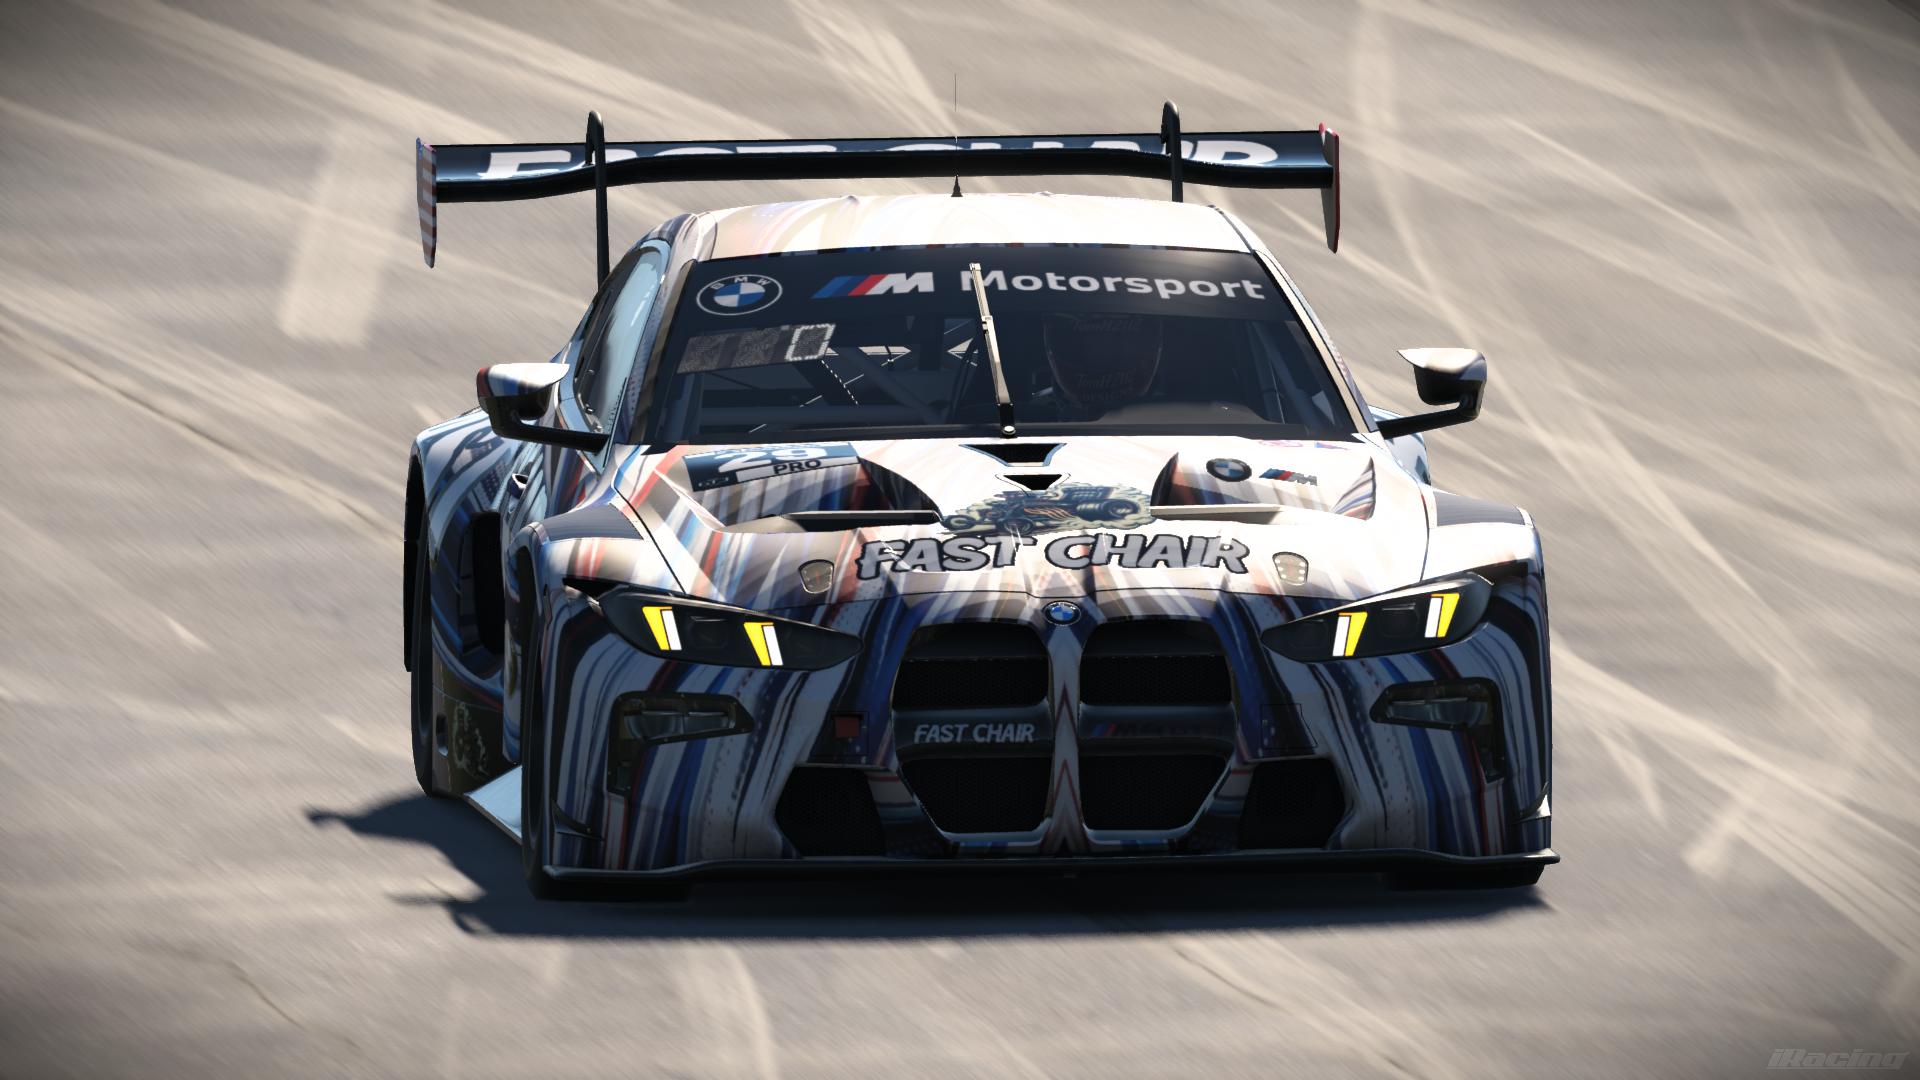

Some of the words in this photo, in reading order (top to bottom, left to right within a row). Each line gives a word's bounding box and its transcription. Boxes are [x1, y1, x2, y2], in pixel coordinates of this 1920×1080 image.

[865, 272, 934, 295] M
[961, 270, 1265, 299] Motorsport
[714, 448, 827, 473] 29
[773, 459, 821, 475] PRO
[857, 534, 1036, 580] FAST
[1045, 534, 1250, 576] CHAIR
[914, 724, 968, 744] FAST
[972, 723, 1036, 743] CHAIR
